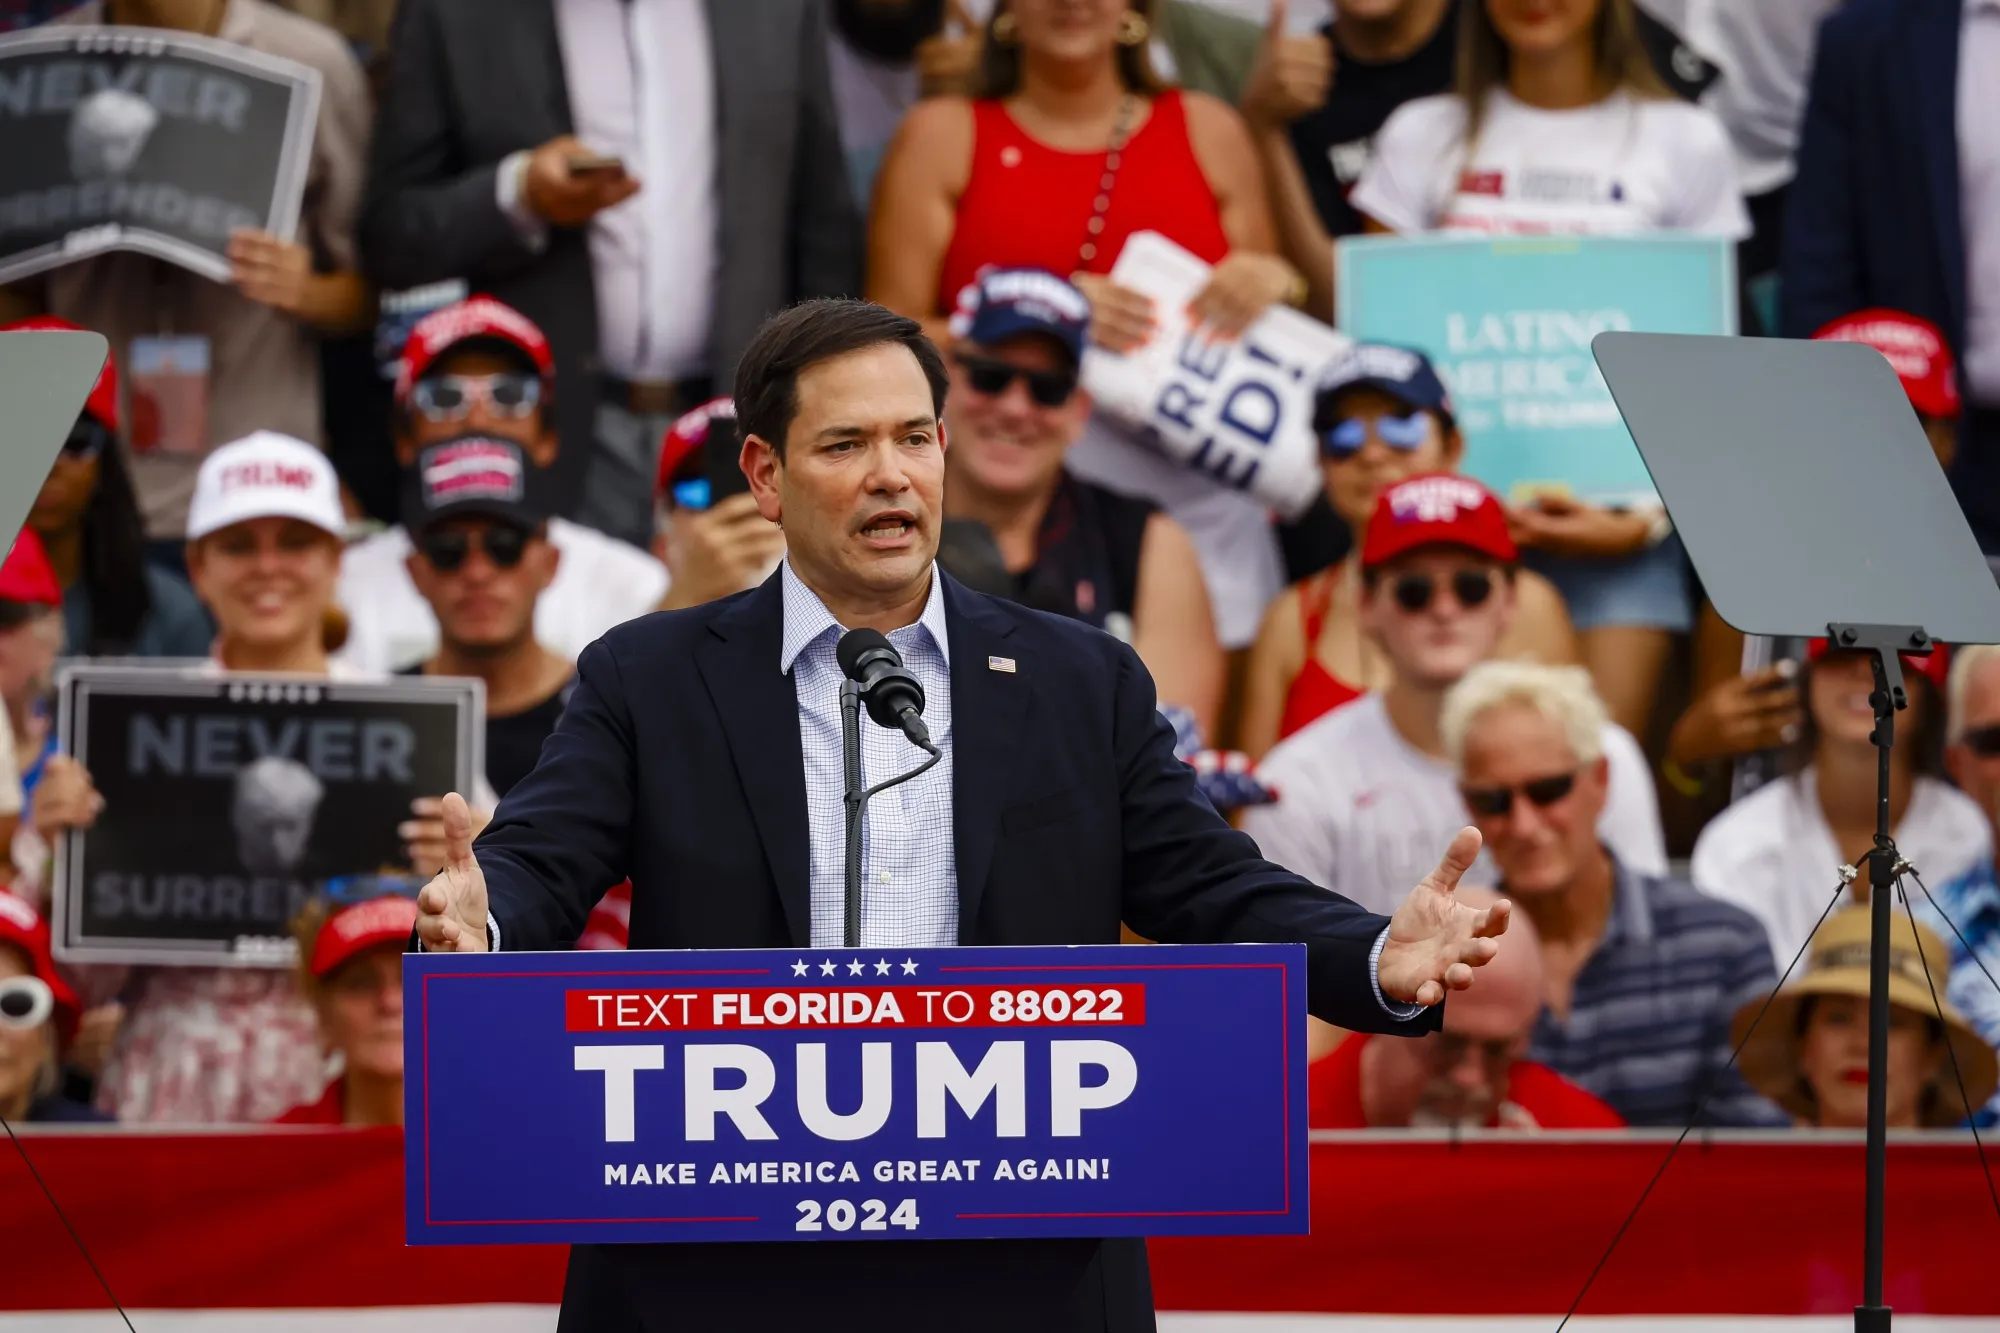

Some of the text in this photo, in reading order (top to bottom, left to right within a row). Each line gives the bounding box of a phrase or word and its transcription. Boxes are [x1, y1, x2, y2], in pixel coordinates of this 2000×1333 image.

[130, 716, 414, 781] NEVER
[588, 989, 1123, 1027] TEXT FLORIDA TO 88022
[574, 1039, 1138, 1143] TRUMP
[604, 1158, 1109, 1186] MAKE AMERICA GREAT AGAIN!
[795, 1198, 920, 1232] 2024
